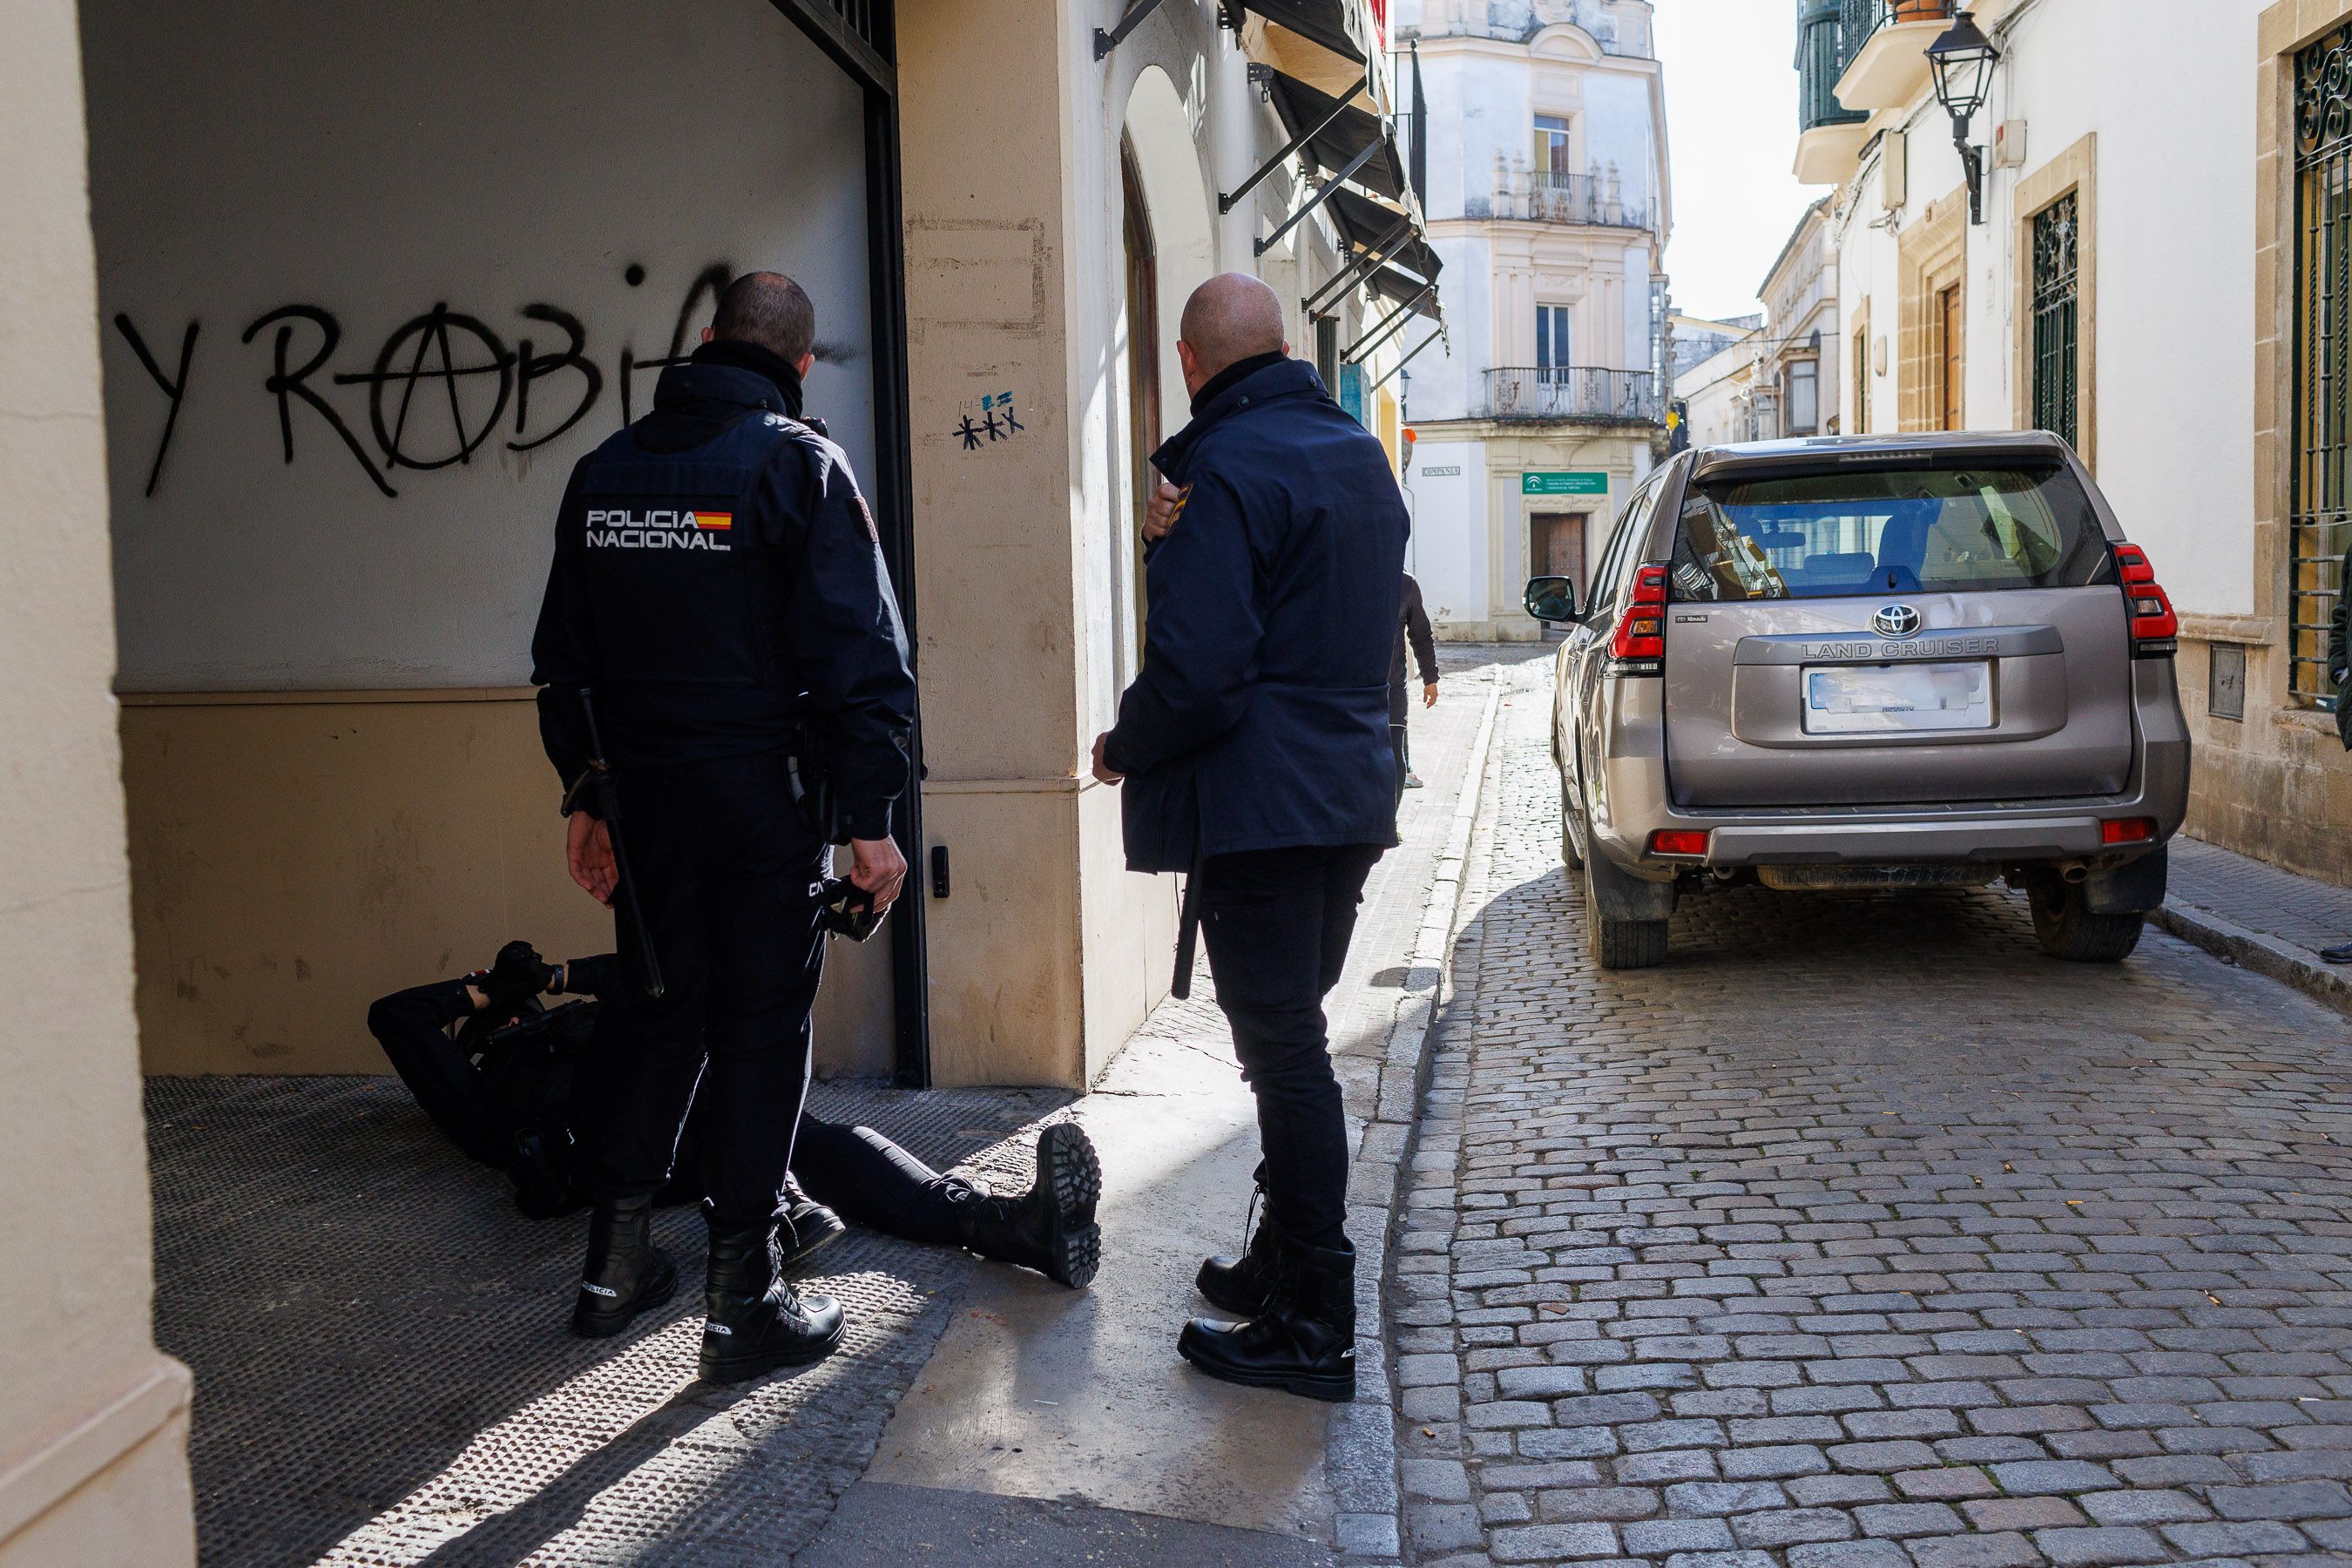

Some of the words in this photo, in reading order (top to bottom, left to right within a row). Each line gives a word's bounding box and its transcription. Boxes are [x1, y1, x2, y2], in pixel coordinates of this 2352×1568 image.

[586, 530, 731, 551] NACIONAL
[1801, 643, 1872, 659] LAND
[1881, 637, 1999, 657] CRUISER
